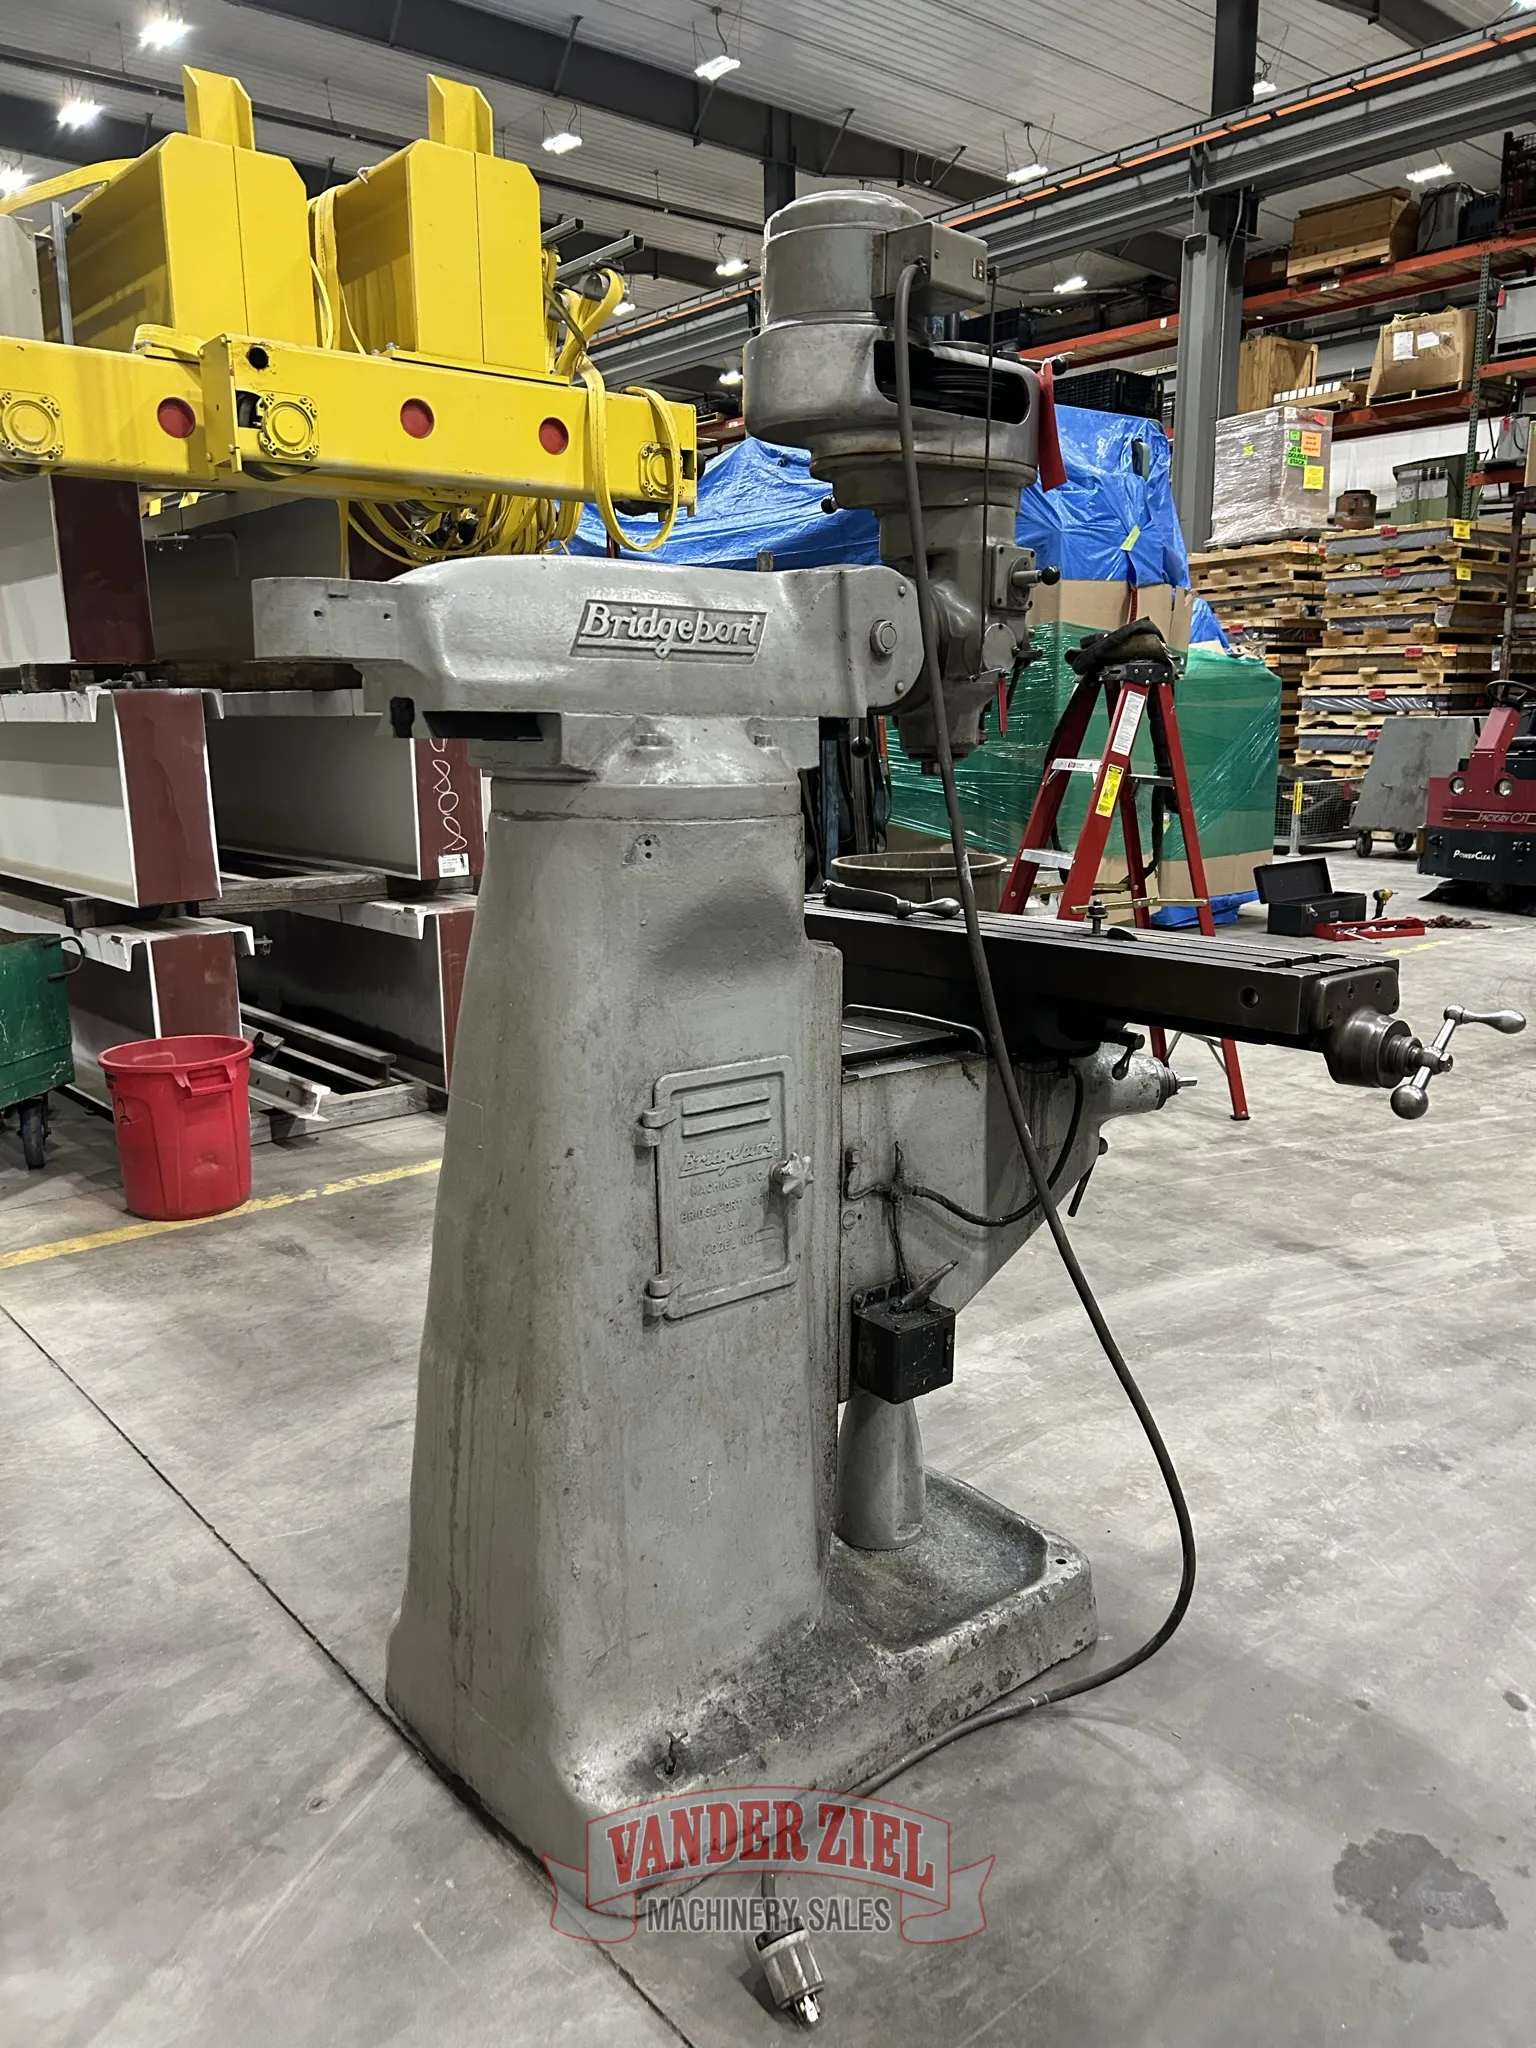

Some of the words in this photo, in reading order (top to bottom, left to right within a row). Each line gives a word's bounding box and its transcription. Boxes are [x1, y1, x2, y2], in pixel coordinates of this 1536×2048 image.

[579, 602, 762, 660] Bridgeport
[680, 1135, 776, 1177] Bridgeport
[690, 1178, 741, 1198] MACHINES
[680, 1198, 743, 1224] BRIDGEPORT
[702, 1239, 737, 1258] MODEL
